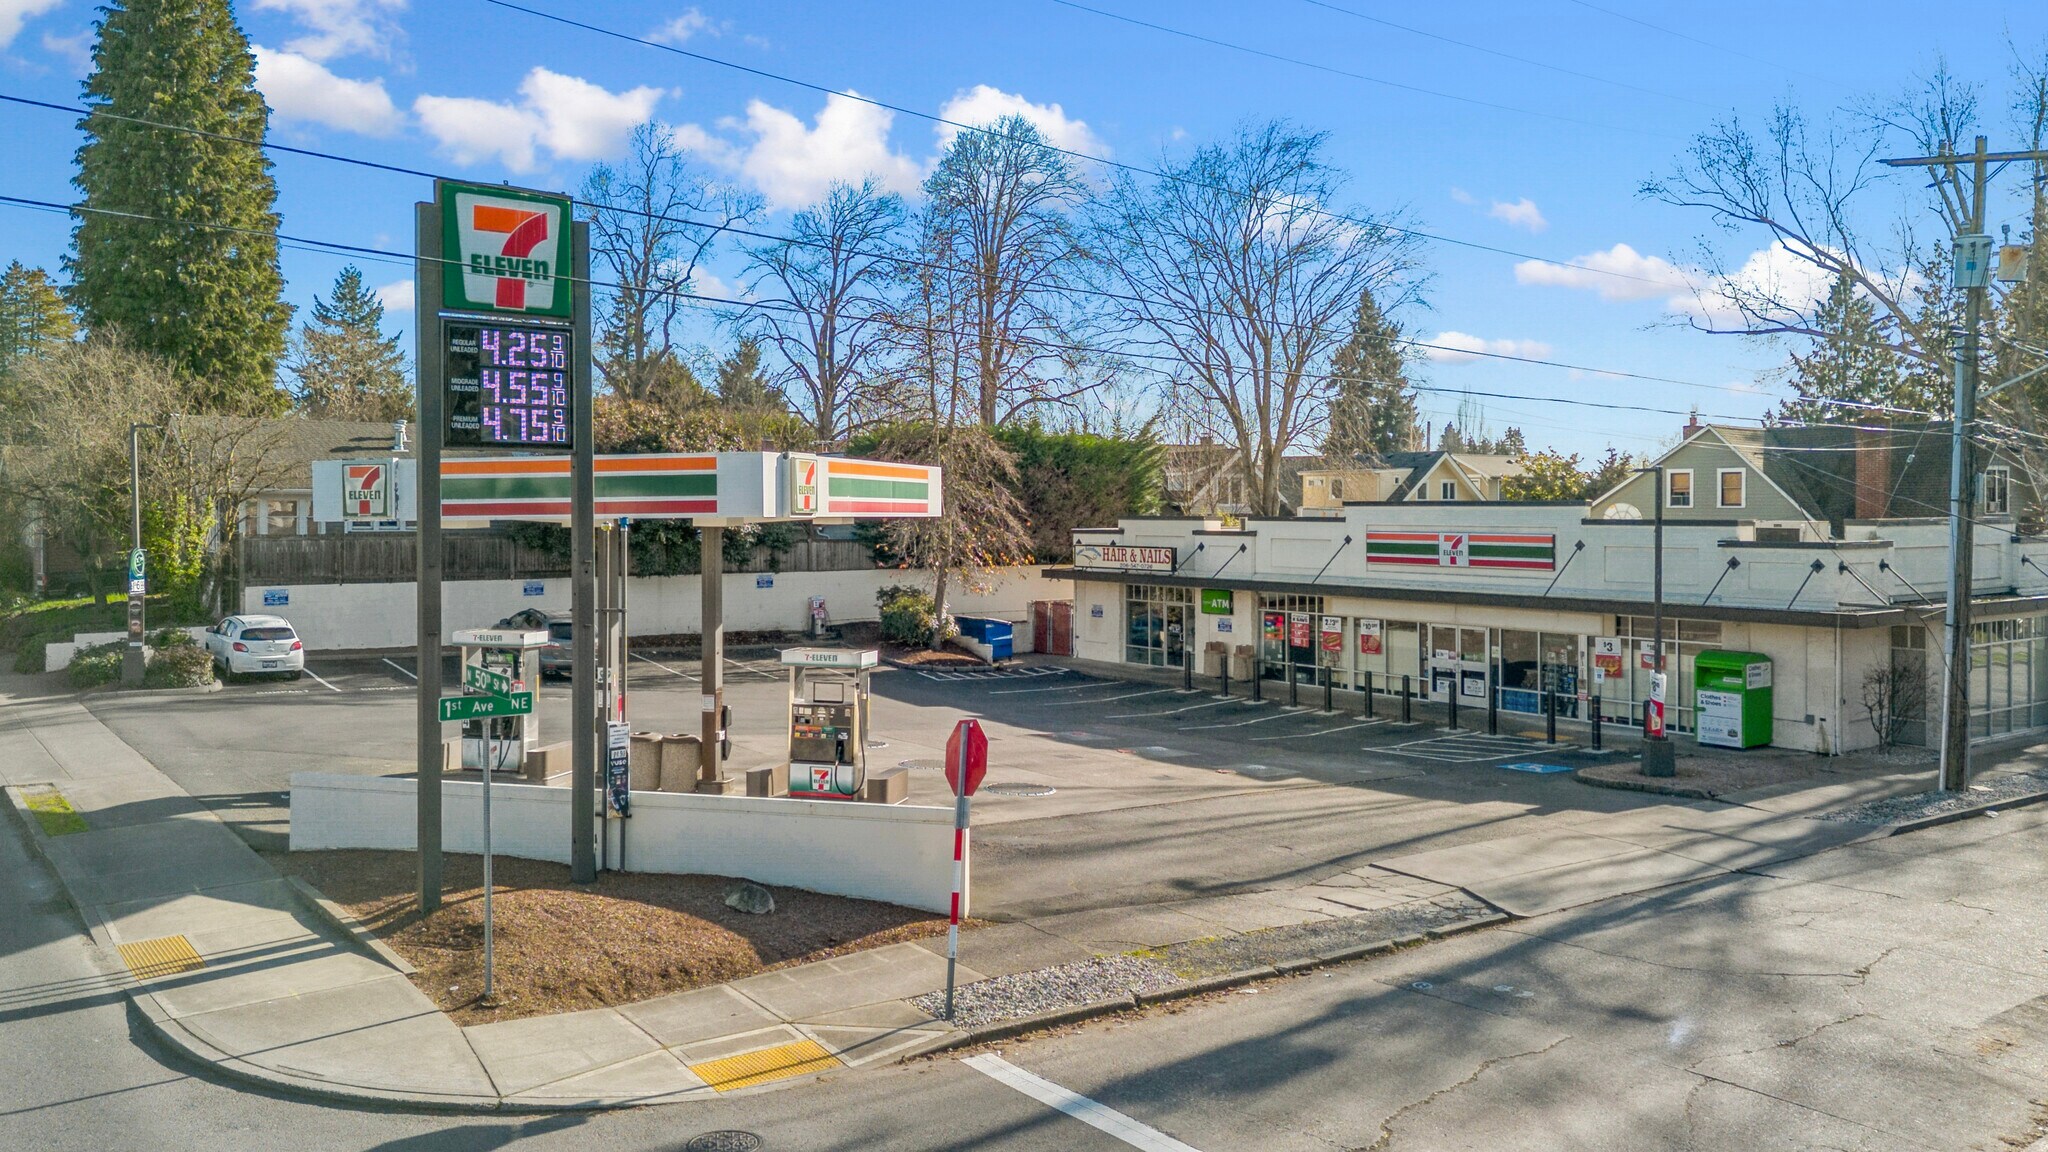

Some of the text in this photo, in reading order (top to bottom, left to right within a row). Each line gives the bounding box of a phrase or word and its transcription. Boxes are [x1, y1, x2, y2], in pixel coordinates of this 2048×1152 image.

[452, 338, 477, 348] REGULAR
[482, 329, 547, 367] 4.25
[450, 345, 479, 354] UNLEADED
[451, 377, 479, 386] MIDGRADE
[483, 369, 548, 404] 4.55
[450, 384, 480, 393] UNLEADED
[452, 414, 479, 424] PREMIUM
[451, 421, 480, 430] UNLEADED
[483, 407, 548, 442] 4.75
[1102, 547, 1127, 562] HAIR
[1130, 548, 1137, 563] &
[1139, 549, 1171, 564] NAILS
[1211, 599, 1230, 609] ATM
[1603, 641, 1613, 652] $3
[467, 669, 472, 681] N
[493, 678, 500, 691] St
[1700, 693, 1722, 701] Clothes
[445, 697, 529, 718] 1st Ave NE
